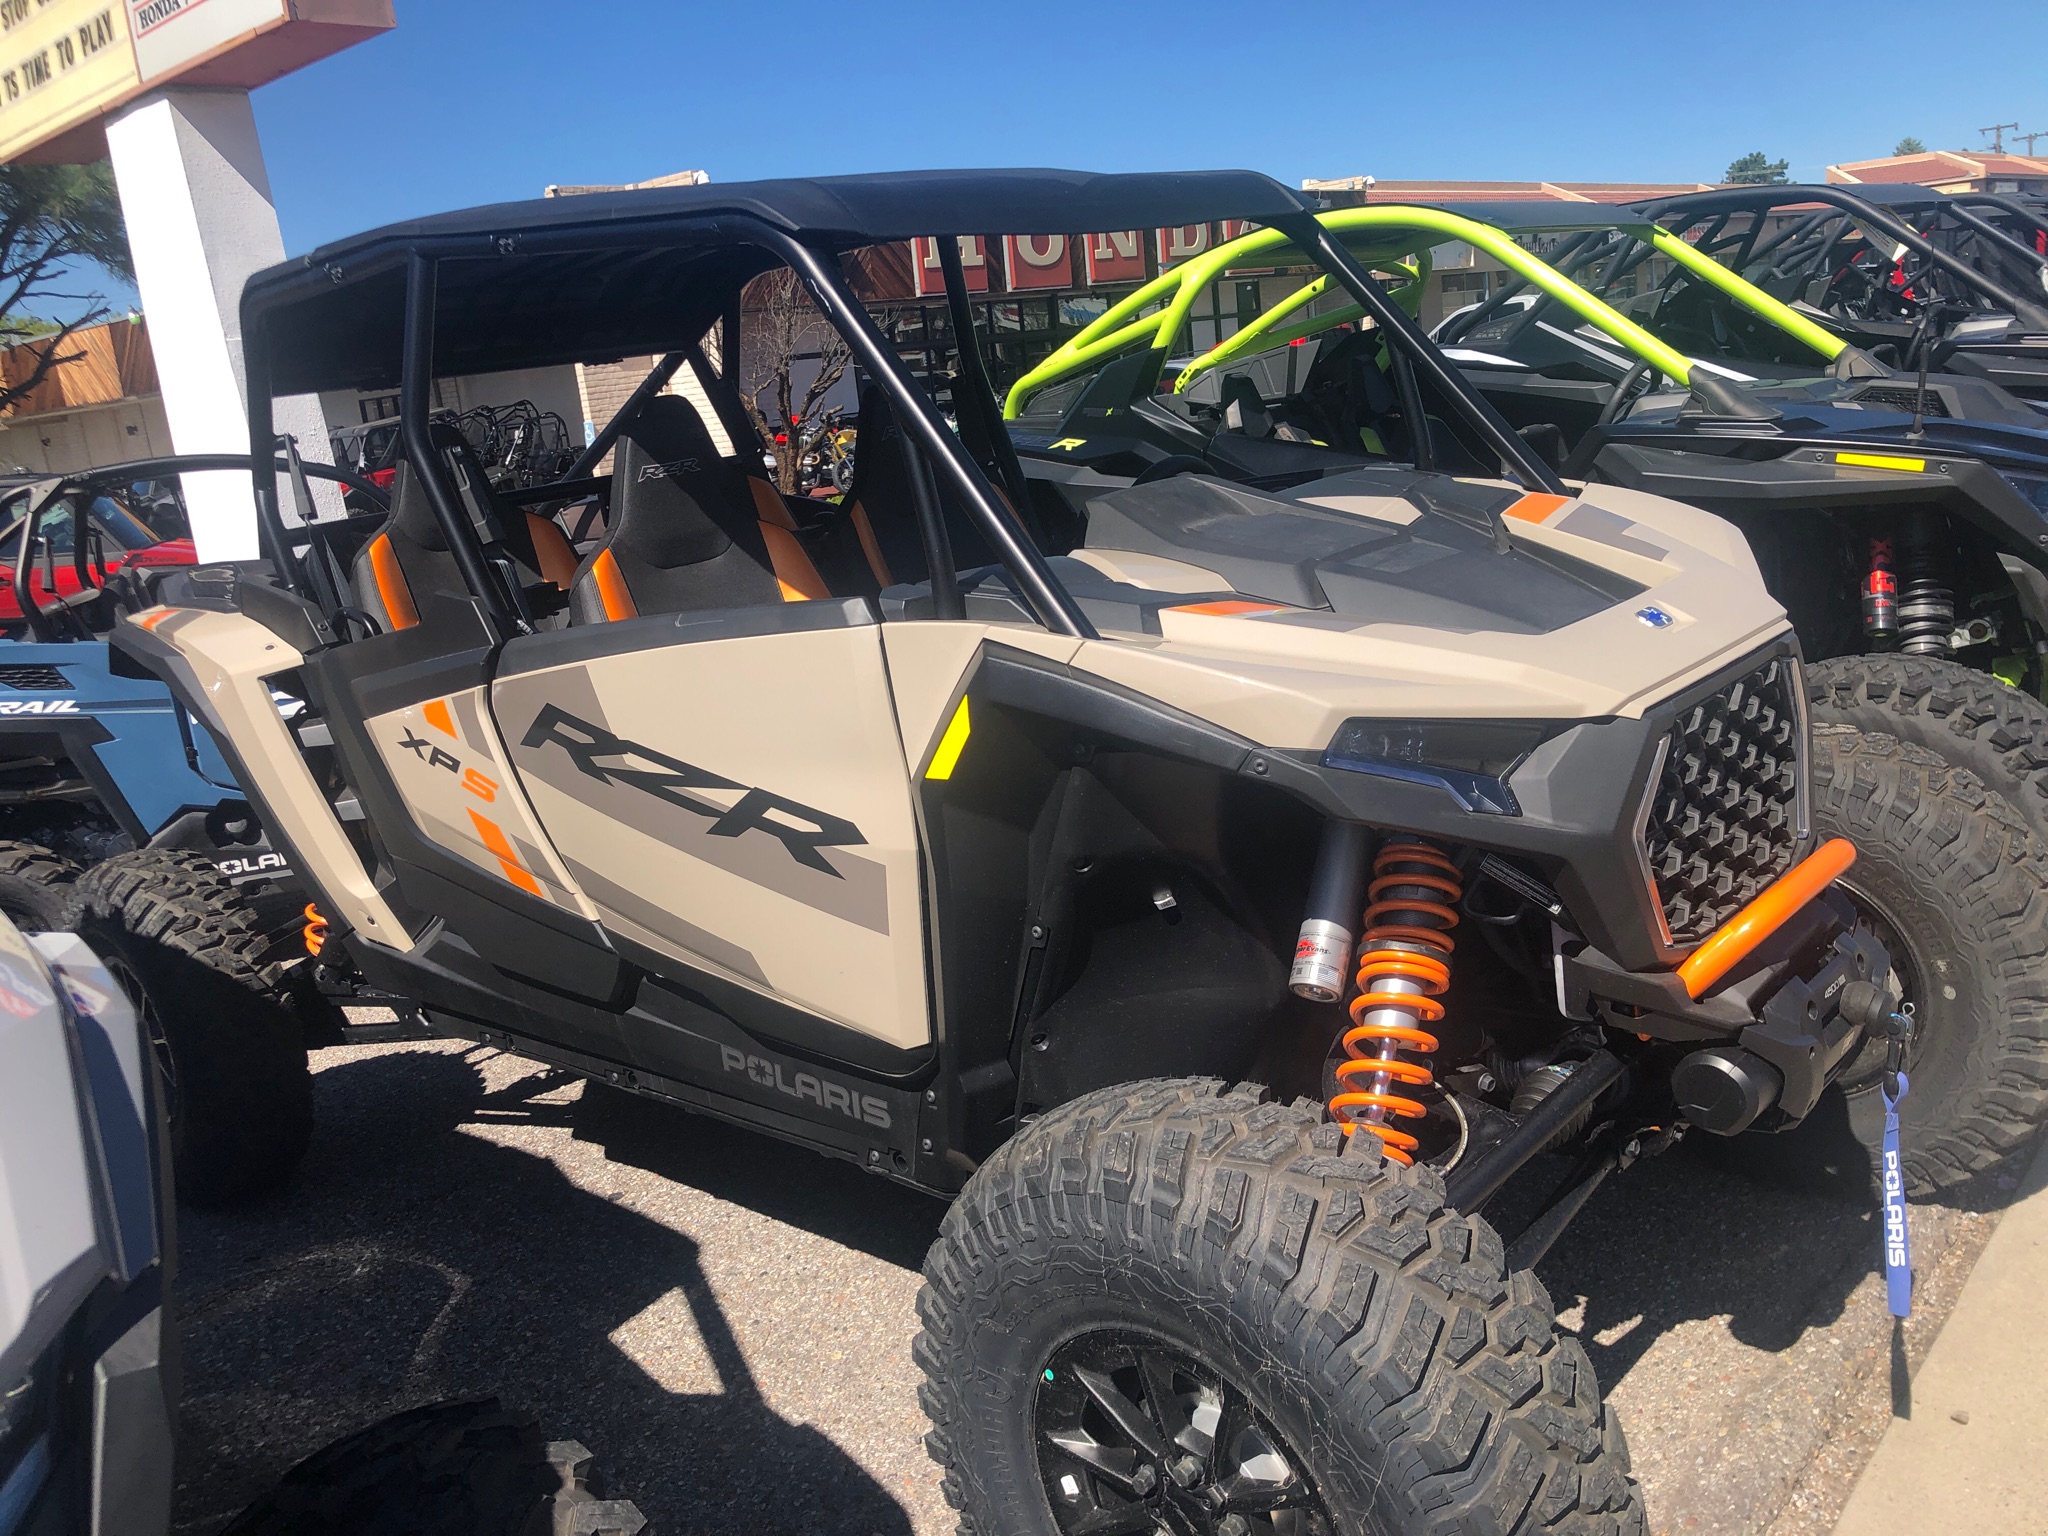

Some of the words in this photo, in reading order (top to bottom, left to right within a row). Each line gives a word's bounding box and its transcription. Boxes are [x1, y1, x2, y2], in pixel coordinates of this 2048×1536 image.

[1, 0, 28, 31] STOP
[139, 0, 181, 29] HONDA
[21, 50, 52, 91] TIME
[56, 36, 75, 70] TO
[78, 10, 114, 57] PLAY
[637, 457, 702, 483] RZR
[520, 702, 870, 881] RZR
[212, 852, 287, 875] OLA
[1824, 980, 1840, 999] 4500
[718, 1043, 892, 1129] POLARIS
[1884, 1150, 1906, 1268] POLARIS
